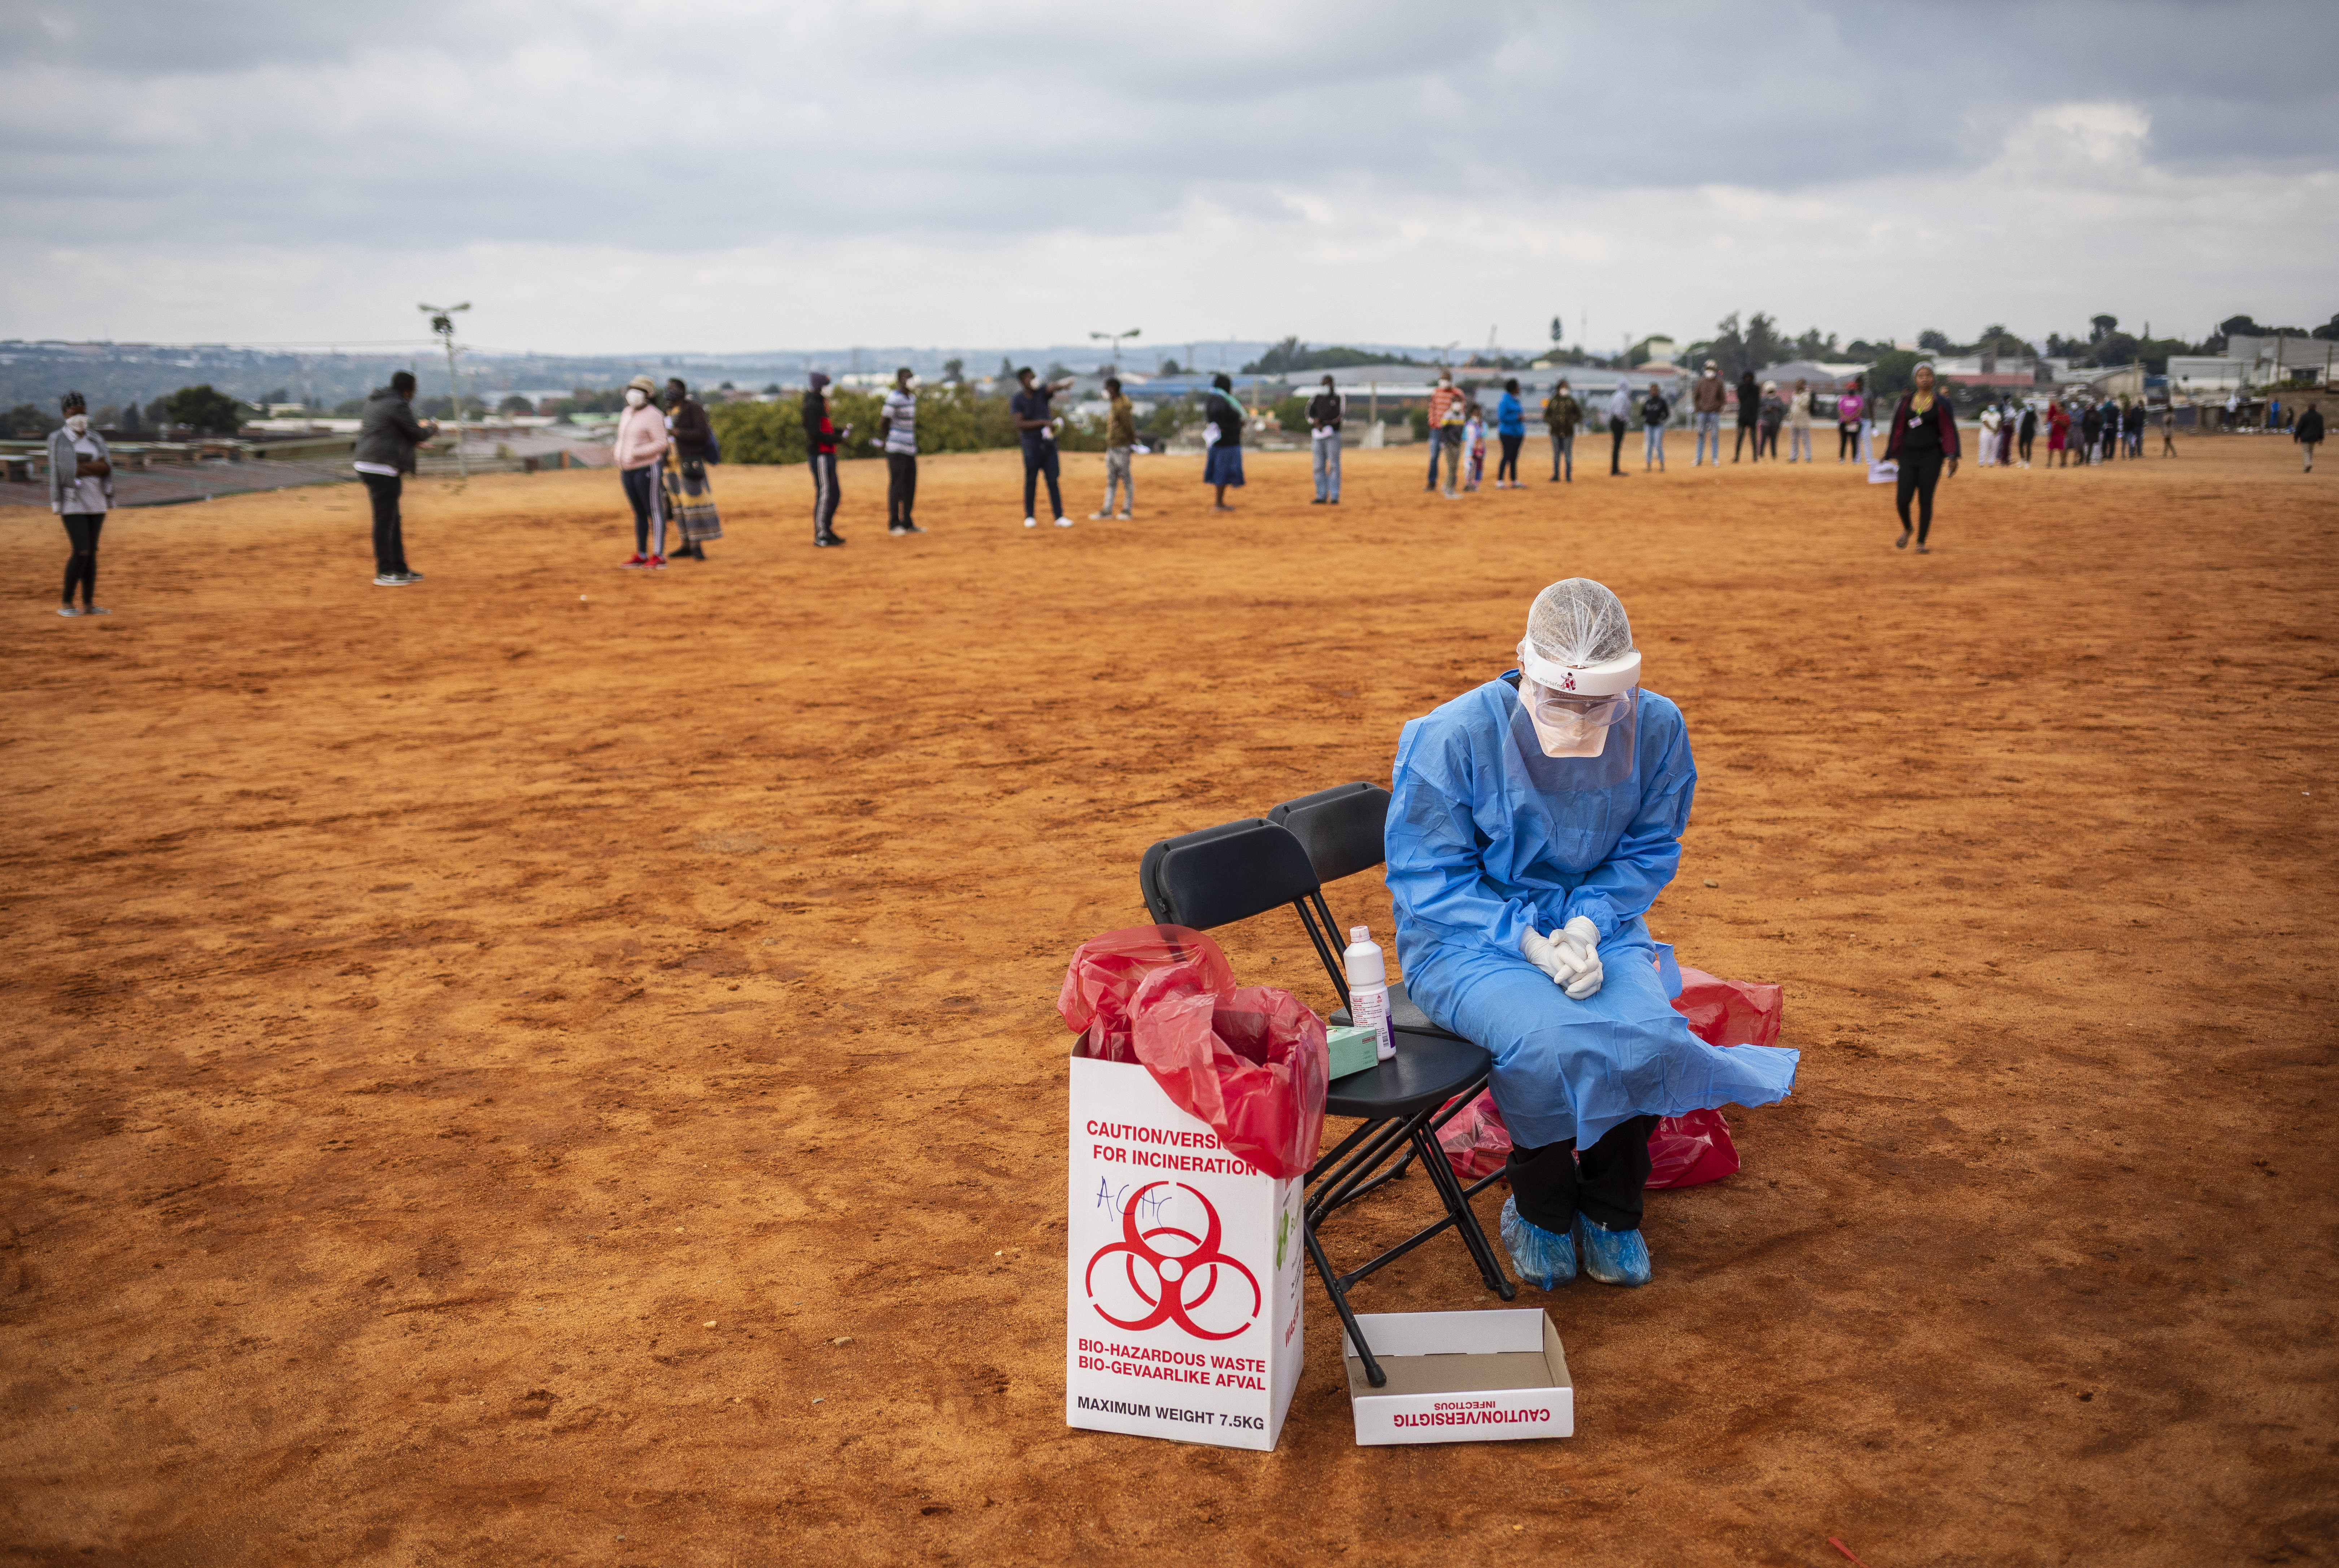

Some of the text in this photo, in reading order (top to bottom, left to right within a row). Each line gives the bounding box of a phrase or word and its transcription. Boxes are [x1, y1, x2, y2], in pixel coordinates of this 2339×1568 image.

[1540, 677, 1560, 687] eva-safe
[1087, 1120, 1227, 1150] CAUTION/VERSI
[1093, 1144, 1257, 1176] FOR INCINERATION
[1285, 1298, 1299, 1348] WASTE
[1079, 1338, 1265, 1373] BIO-HAZARDOUS WASTE
[1079, 1355, 1266, 1390] BIO-GEVAARLIKE AFVAL
[1078, 1396, 1264, 1430] MAXIMUM WEIGHT 7.5KG
[1394, 1409, 1550, 1427] CAUTION/VERSIGTIG
[1434, 1401, 1495, 1410] INFECTIOUS
